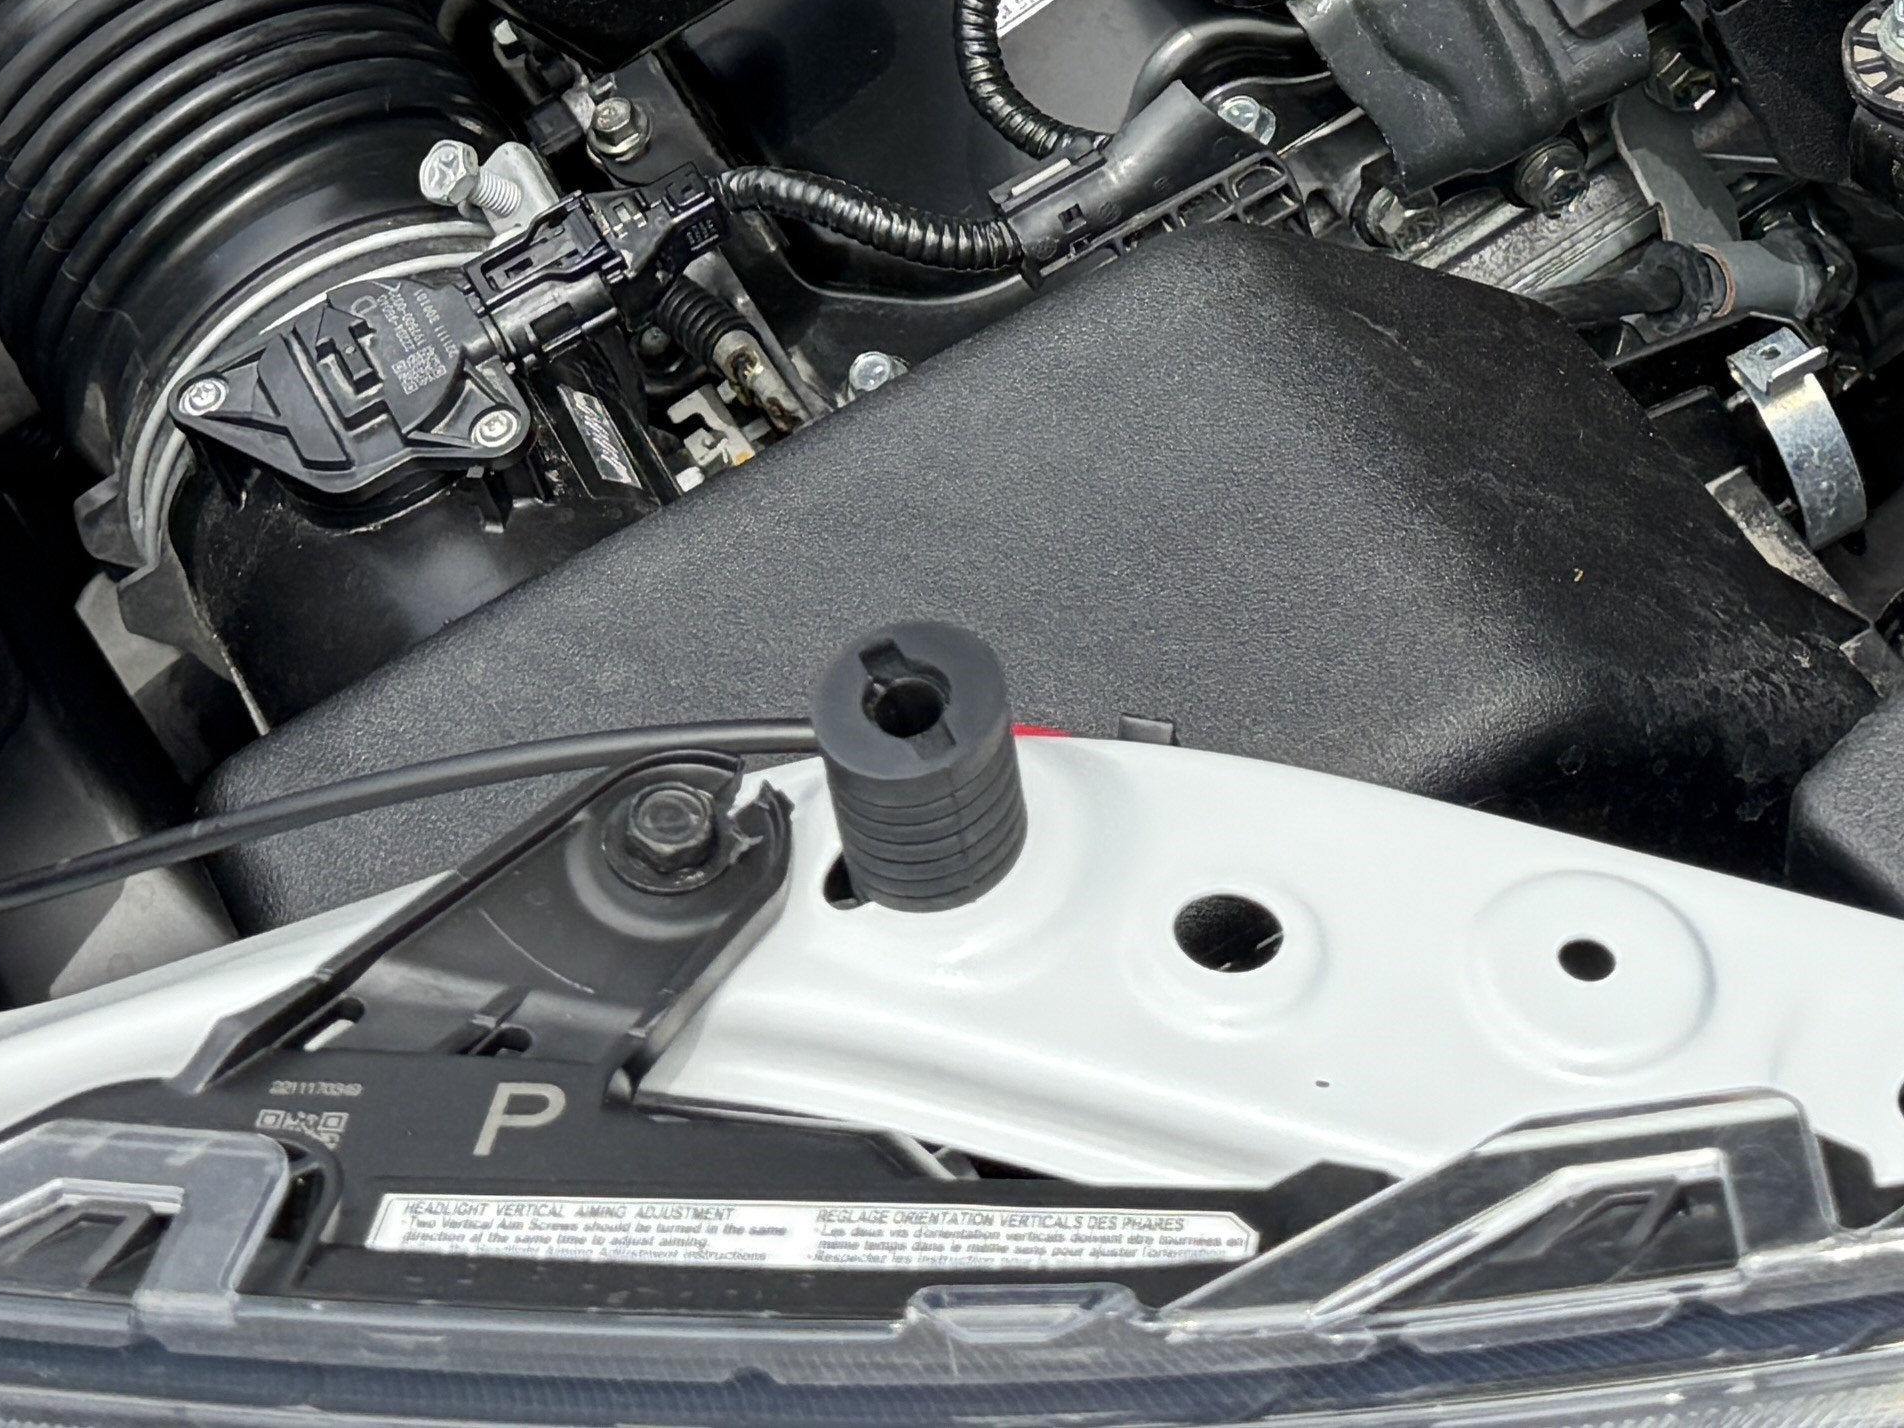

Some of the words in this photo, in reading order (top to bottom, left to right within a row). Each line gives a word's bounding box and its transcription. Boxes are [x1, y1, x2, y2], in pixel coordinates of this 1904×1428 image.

[473, 1081, 566, 1157] P
[404, 1201, 489, 1216] HEADLIGHT
[496, 1203, 565, 1218] VERTICAL
[573, 1205, 627, 1219] AIMING
[634, 1206, 736, 1221] ADJUSTMENT
[442, 1216, 494, 1230] Vertical
[497, 1218, 524, 1231] Aim
[527, 1217, 579, 1232] Screws
[583, 1221, 631, 1232] should
[635, 1222, 652, 1233] be
[656, 1224, 702, 1234] turned
[706, 1225, 719, 1234] in
[722, 1223, 746, 1235] the
[749, 1226, 788, 1236] same
[893, 1211, 994, 1226] ORIENTATION
[1000, 1214, 1083, 1230] VERTICALS
[1086, 1216, 1118, 1231] DES
[1121, 1216, 1184, 1232] PHARES
[402, 1230, 465, 1243] direction
[469, 1231, 484, 1243] at
[487, 1232, 510, 1244] the
[514, 1235, 552, 1245] same
[556, 1234, 588, 1246] time
[592, 1234, 607, 1246] to
[609, 1236, 655, 1249] adjust
[851, 1225, 884, 1237] deux
[890, 1228, 909, 1238] vis
[1226, 1237, 1244, 1247] en
[864, 1241, 907, 1254] temps
[911, 1241, 946, 1252] dans
[950, 1240, 963, 1253] le
[1015, 1245, 1047, 1255] sens
[1051, 1247, 1085, 1258] pour
